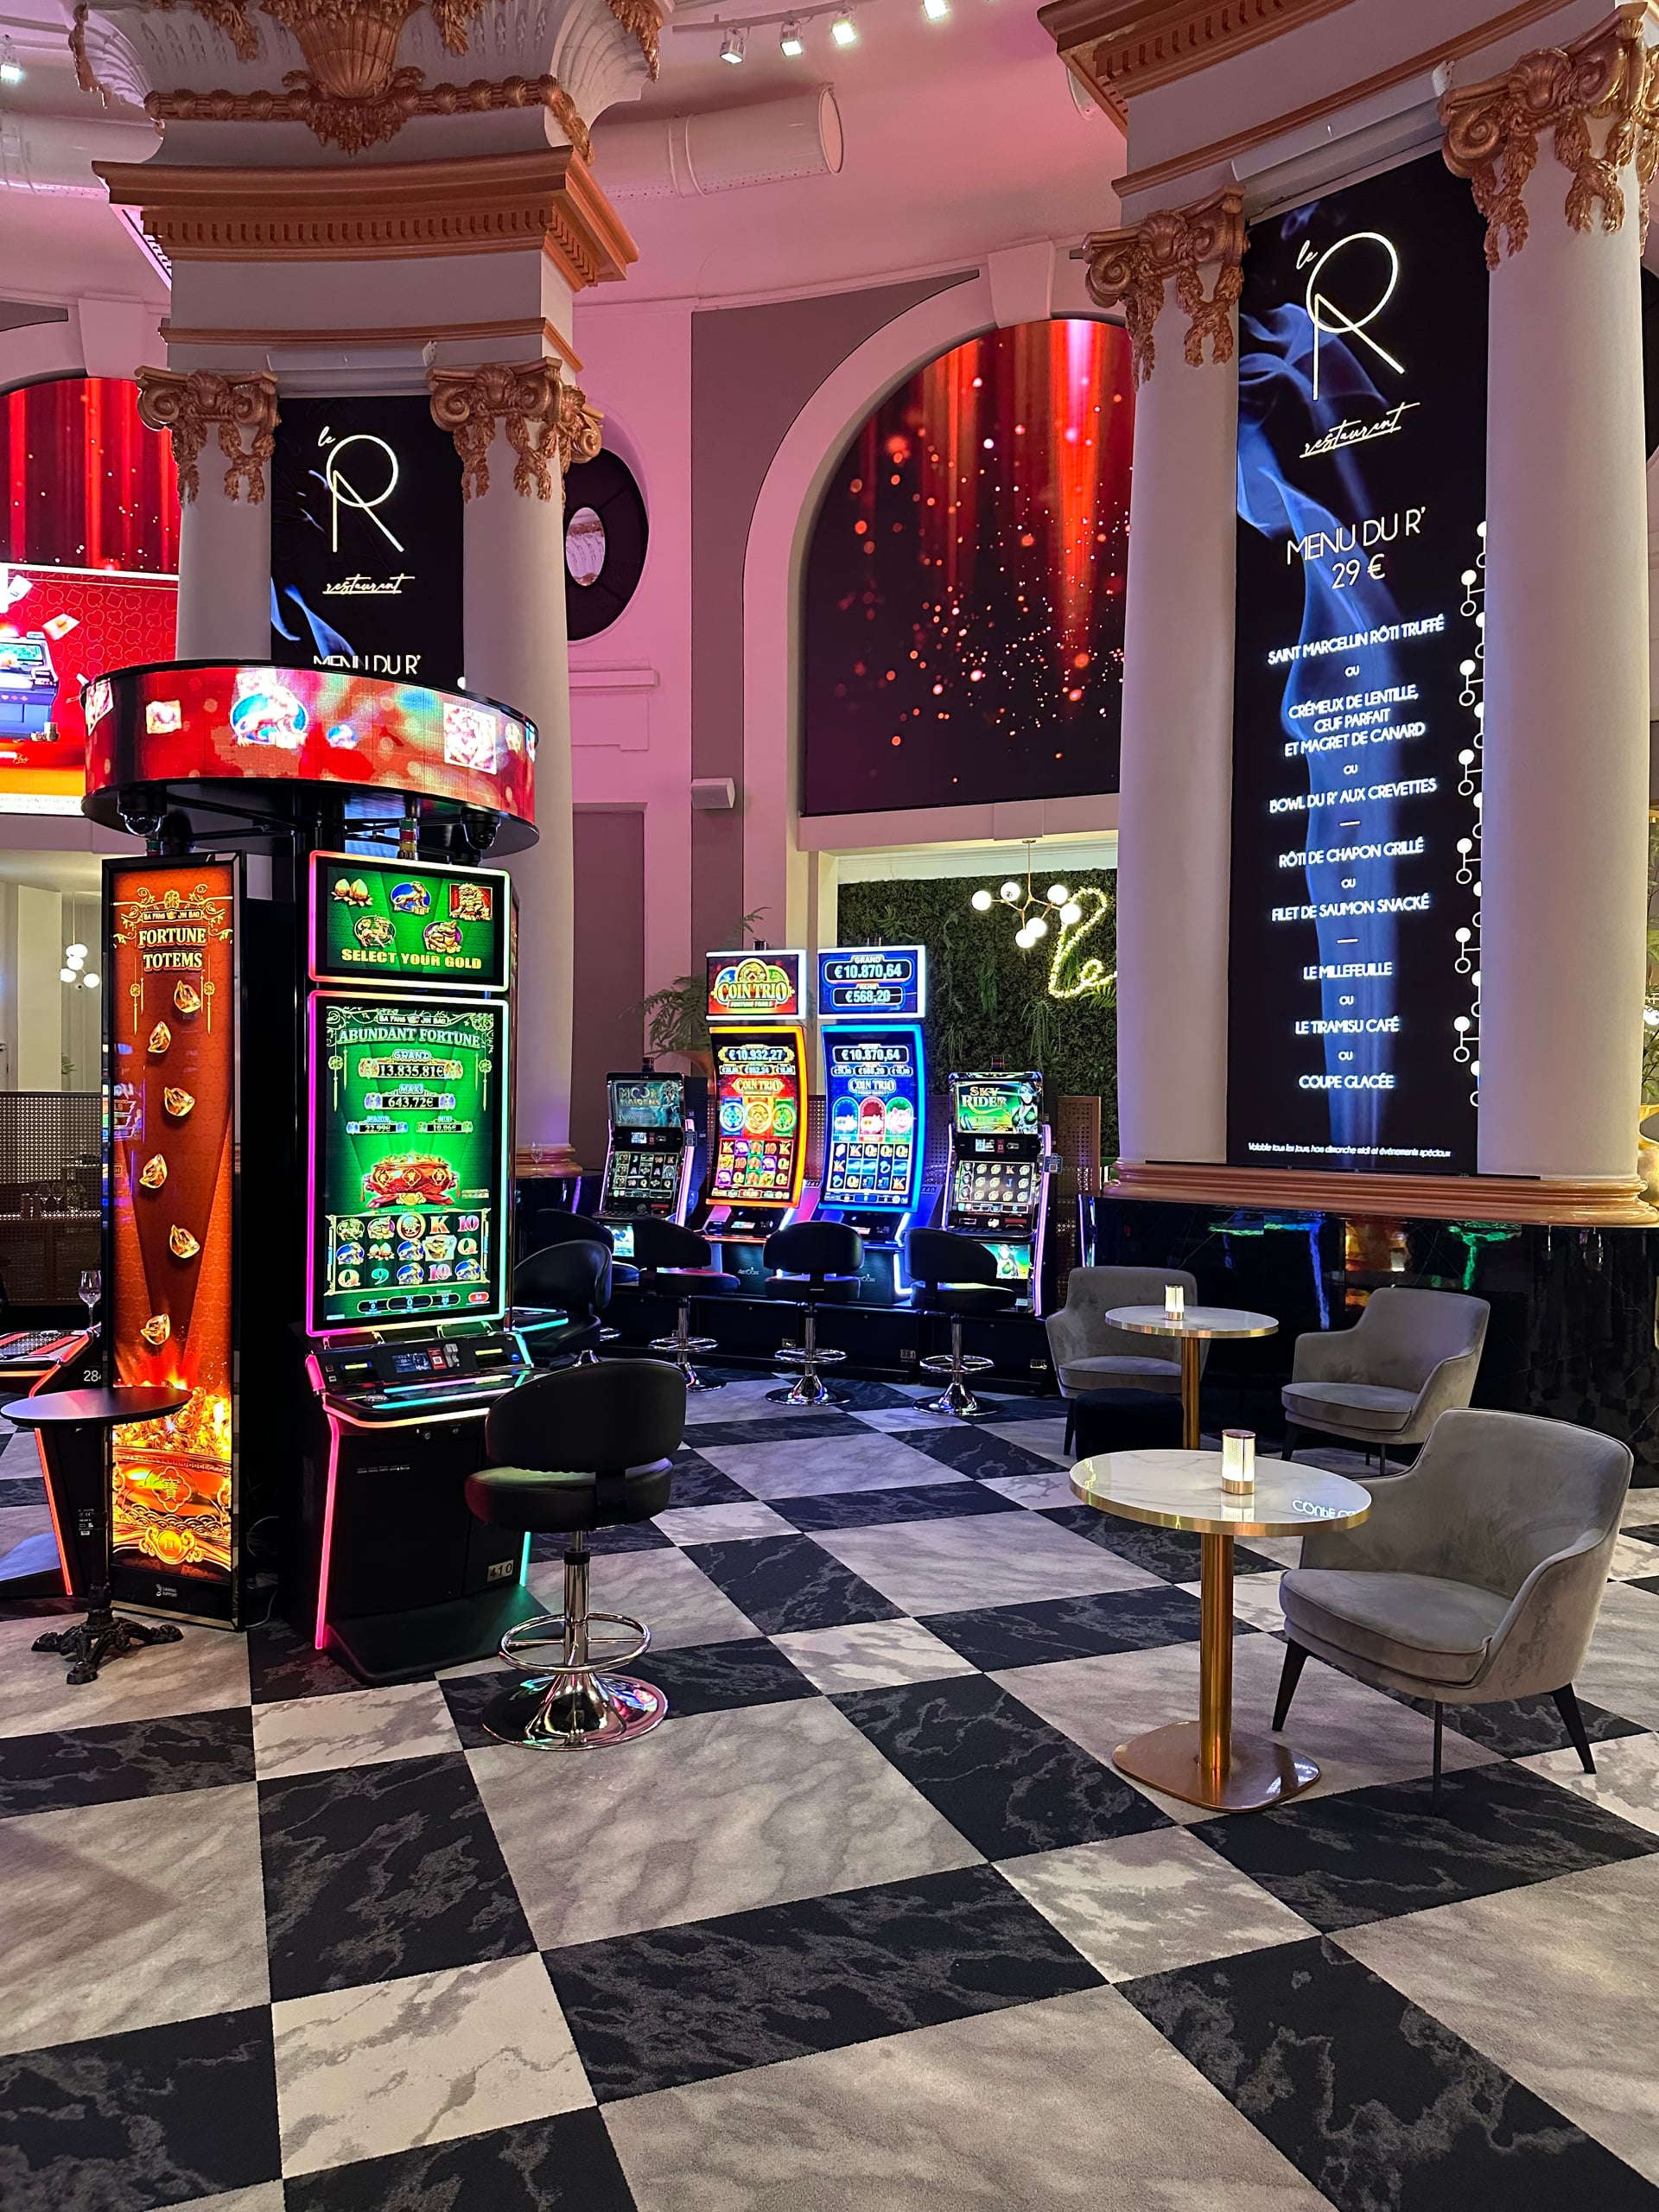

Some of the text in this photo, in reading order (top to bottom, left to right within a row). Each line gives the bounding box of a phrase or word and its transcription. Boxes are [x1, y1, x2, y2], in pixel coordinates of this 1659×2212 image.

[1306, 232, 1406, 400] R
[1300, 402, 1421, 458] restaurant
[327, 434, 404, 552] R
[1287, 528, 1356, 565] MENU
[1363, 512, 1398, 547] DU
[1332, 553, 1386, 589] 29 €
[322, 573, 415, 594] restaurant
[1268, 613, 1444, 664] SAINT MARCELLIN RÔTI TRUFFÉ
[373, 654, 401, 674] DU
[1288, 684, 1418, 719] CRÉMEUX DE LENTILLE,
[1344, 709, 1390, 729] PARFAIT
[1285, 722, 1426, 757] ET MAGRET DE CANARD
[1269, 797, 1306, 814] BOWL
[1307, 793, 1325, 808] DU
[1340, 789, 1365, 804] AUX
[1368, 778, 1437, 799] CREVETTES
[1279, 836, 1424, 868] RÔTI DE CHAPON GRILLÉ
[1272, 893, 1430, 921] FILET DE SAUMON SNACKÉ
[138, 927, 207, 947] FORTUNE
[143, 952, 203, 969] TOTEMS
[341, 949, 482, 969] SELECT YOUR GOLD
[1304, 962, 1392, 980] LE MILLEFEUILLE
[717, 982, 788, 1002] COIN TRIO
[1295, 1016, 1399, 1034] LE TIRAMISU CAFÉ
[337, 1027, 481, 1047] ABUNDANT FORTUNE
[393, 1050, 431, 1059] GRAND
[736, 1078, 779, 1091] COIN TRIO
[850, 1079, 894, 1091] COIN TRIO
[1299, 1072, 1395, 1089] COUPE GLACÉE
[619, 1087, 660, 1098] MOON
[961, 1095, 1007, 1107] RIDER
[969, 1086, 1000, 1096] SKY
[430, 1216, 480, 1234] K 10
[457, 1237, 478, 1255] Q
[338, 1263, 452, 1287] Q 9 10
